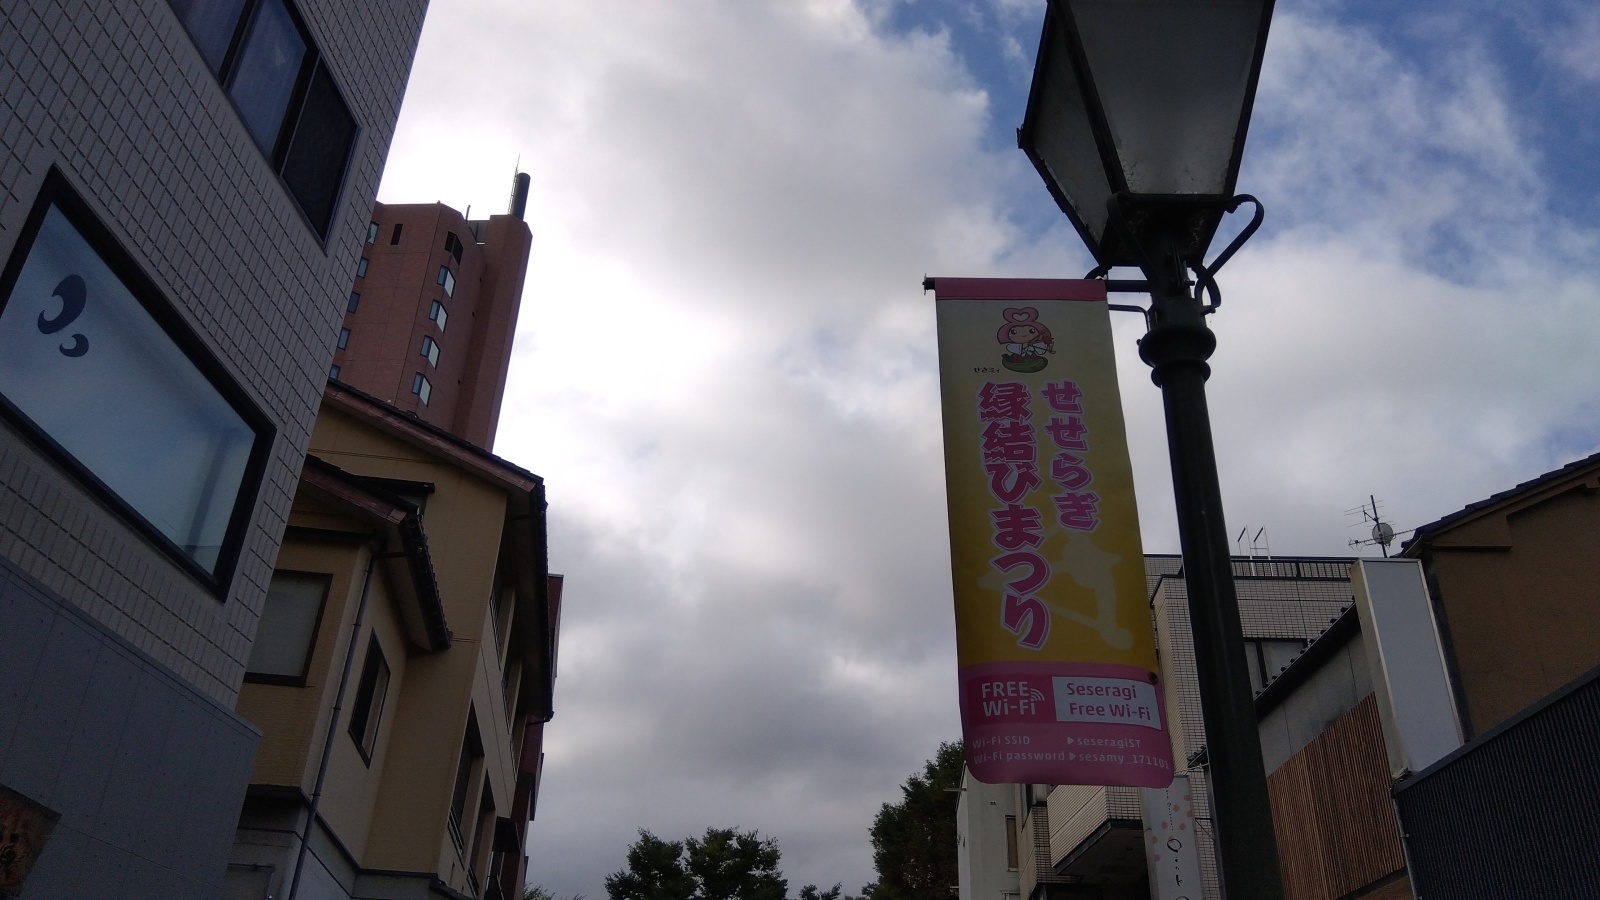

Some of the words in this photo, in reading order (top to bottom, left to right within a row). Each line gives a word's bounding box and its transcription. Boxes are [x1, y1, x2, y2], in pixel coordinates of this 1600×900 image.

[1040, 381, 1100, 531] せせらぎ
[978, 381, 1050, 651] 縁結びまつり
[981, 681, 1029, 698] FREE
[1066, 682, 1137, 701] Seseragi
[982, 699, 1036, 717] Wi-Fi
[1069, 702, 1105, 716] Free
[1109, 704, 1151, 721] Wi-Fi
[972, 736, 1001, 749] Wi-Fi
[1005, 735, 1030, 746] SSID
[1077, 737, 1141, 749] seseragiST
[974, 752, 1003, 765] Wi-Fi
[1006, 751, 1065, 763] password
